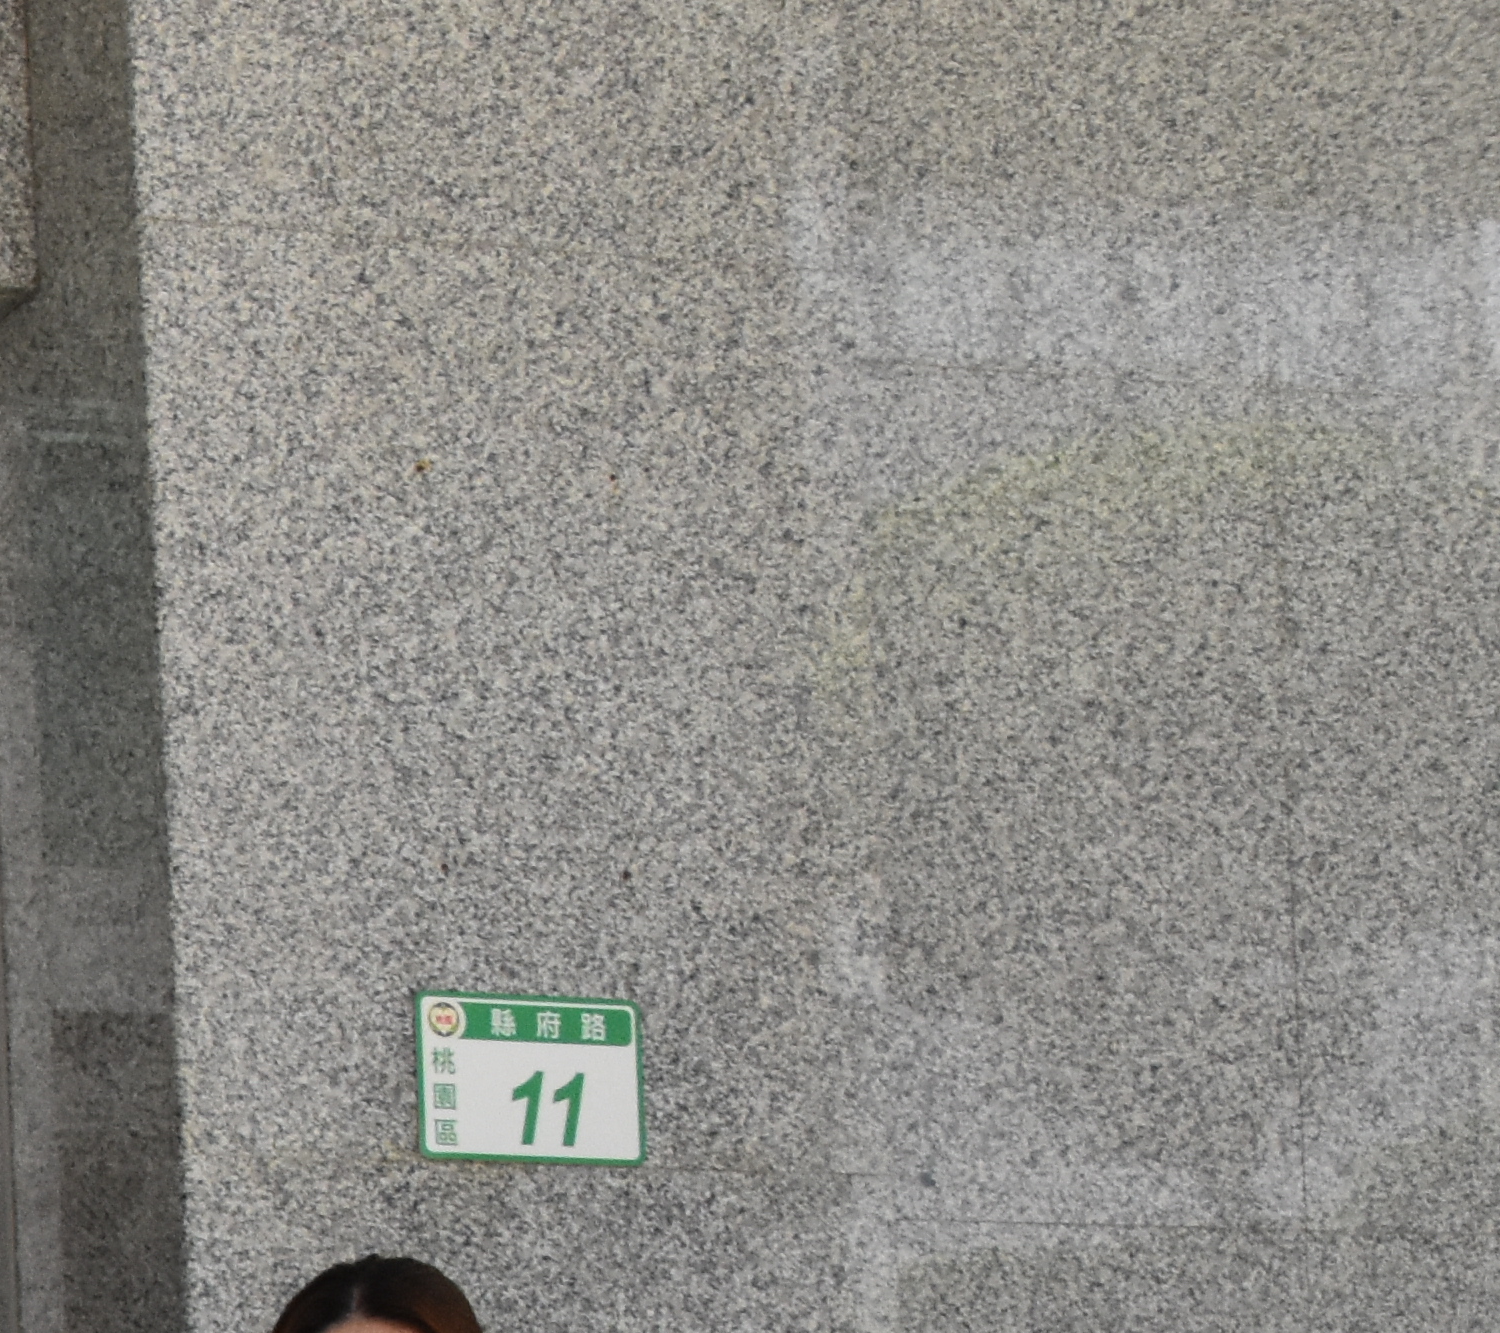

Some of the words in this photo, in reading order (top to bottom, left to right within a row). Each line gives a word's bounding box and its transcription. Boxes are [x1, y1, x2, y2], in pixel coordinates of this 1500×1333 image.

[489, 1007, 607, 1042] 縣府路
[431, 1046, 458, 1146] 桃園區
[511, 1069, 585, 1148] 11
